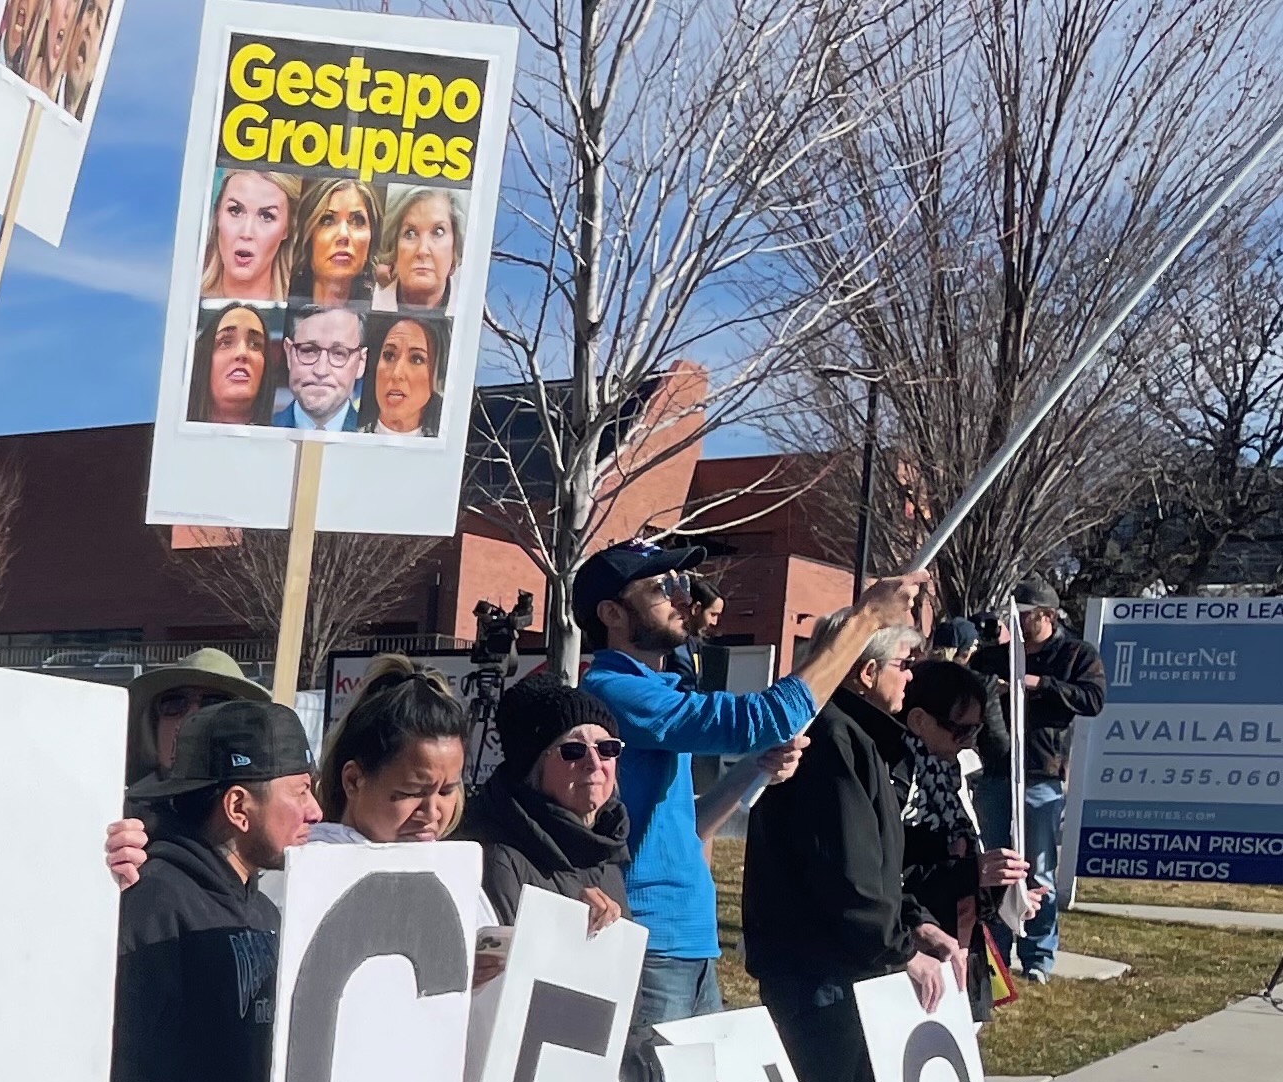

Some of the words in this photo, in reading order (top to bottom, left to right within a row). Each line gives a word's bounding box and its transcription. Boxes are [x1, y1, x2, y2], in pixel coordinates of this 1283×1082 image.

[229, 43, 481, 128] Gestapo
[221, 103, 475, 182] Groupies
[1113, 603, 1188, 620] OFFICE
[1196, 603, 1239, 619] FOR
[1141, 647, 1238, 667] InterNet
[1139, 670, 1236, 681] PROPERTIES
[1105, 720, 1282, 743] AVAILABL
[1088, 832, 1201, 852] CHRISTIAN
[1208, 836, 1283, 856] PRISKO
[1086, 858, 1148, 876] CHRIS
[1156, 861, 1230, 879] METOS
